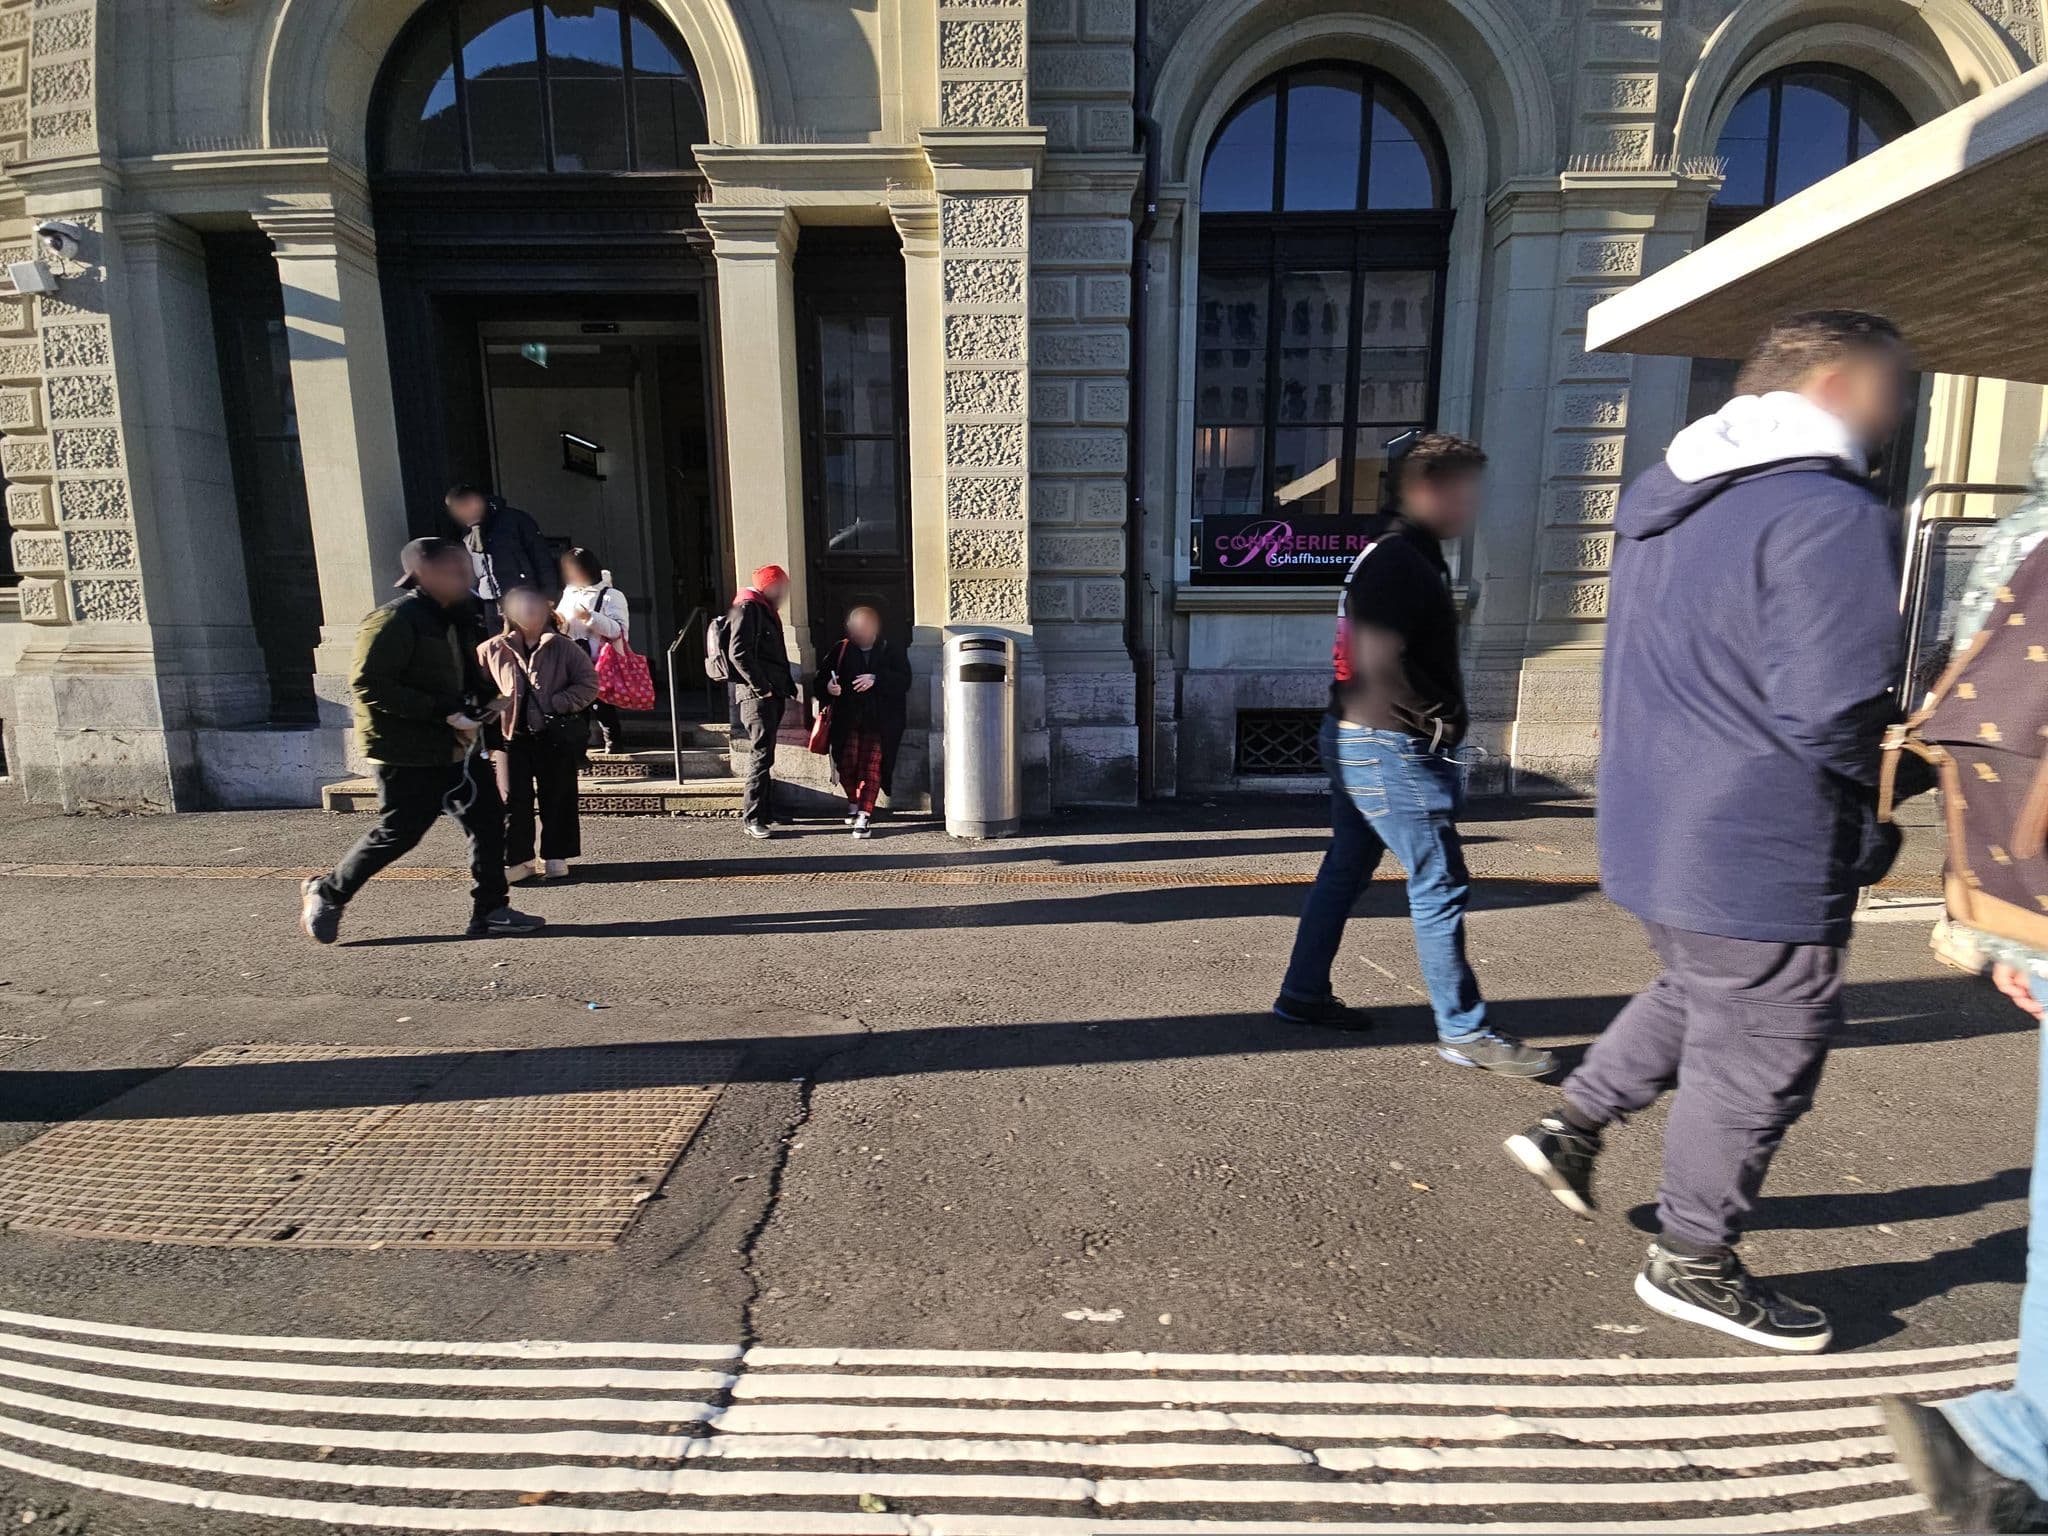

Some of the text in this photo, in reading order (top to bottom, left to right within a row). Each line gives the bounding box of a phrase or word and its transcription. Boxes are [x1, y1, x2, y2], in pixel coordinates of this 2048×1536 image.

[1215, 535, 1369, 550] CONFISERIE RE
[1271, 553, 1356, 564] Schaffhauserz
